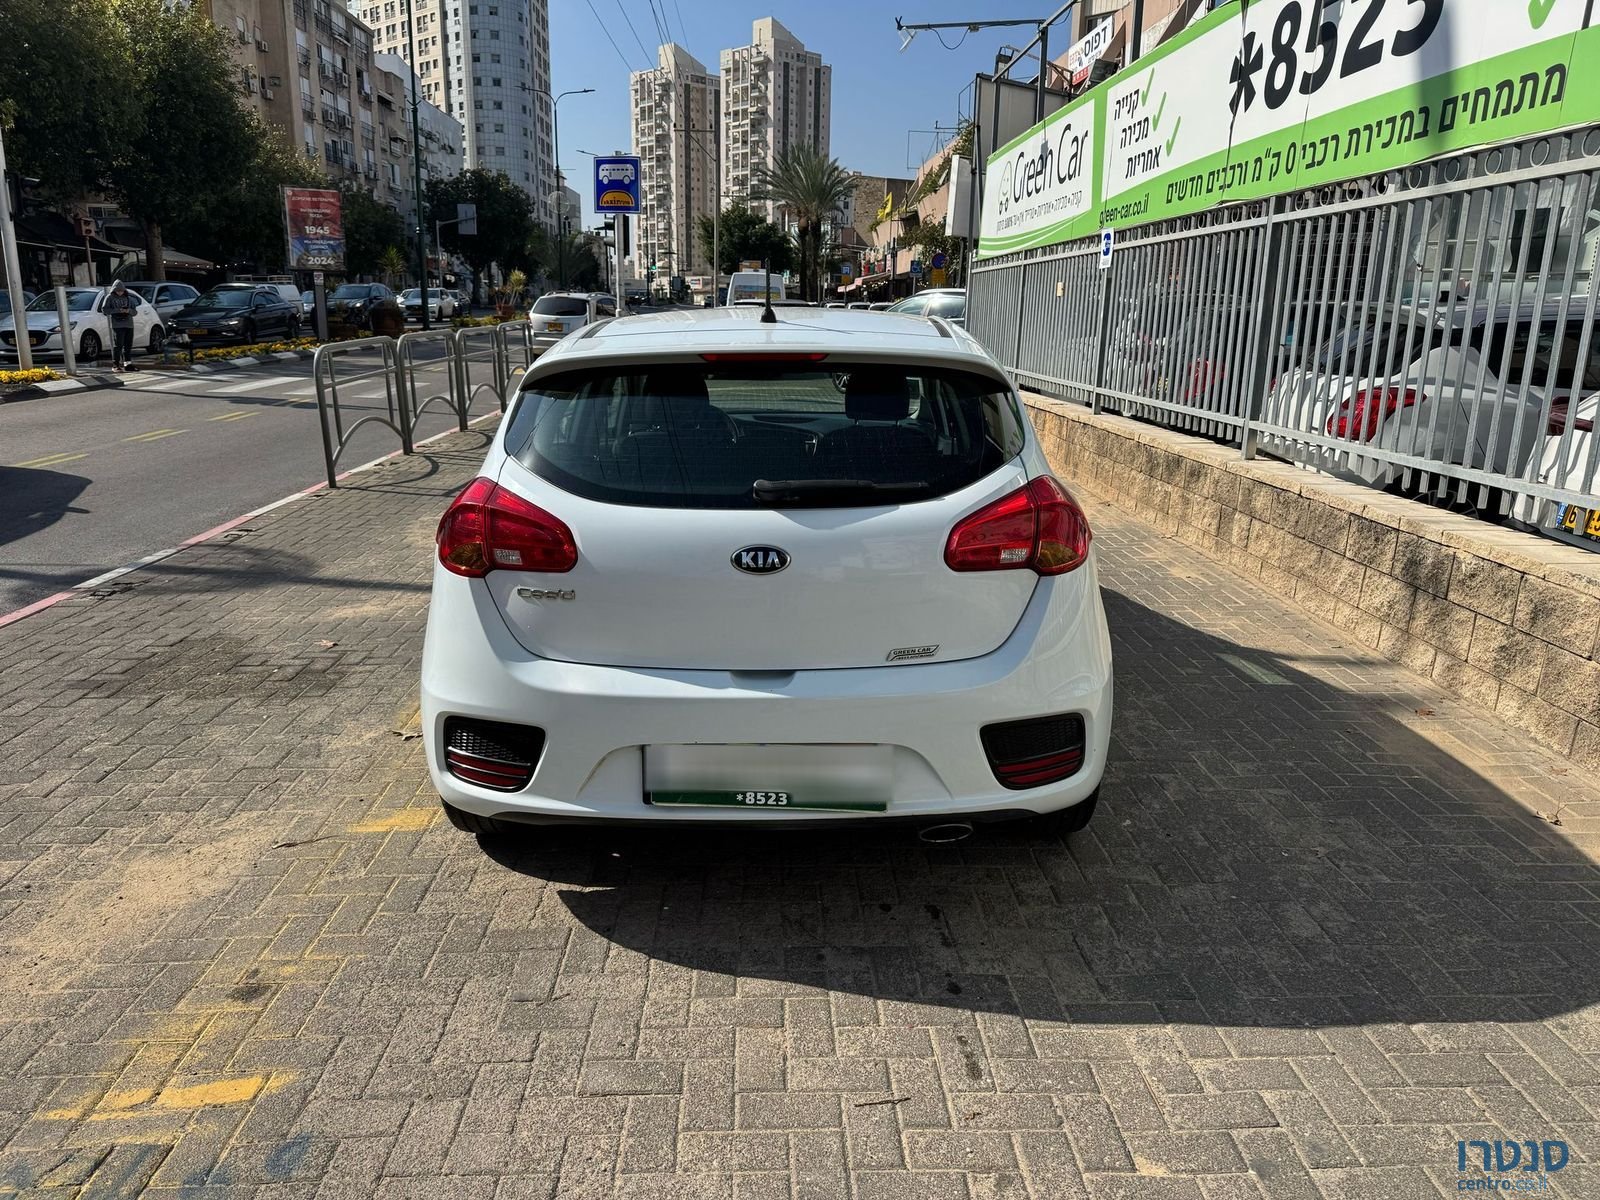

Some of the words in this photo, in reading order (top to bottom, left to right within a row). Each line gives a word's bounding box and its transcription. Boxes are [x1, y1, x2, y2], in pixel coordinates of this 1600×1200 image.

[1084, 25, 1107, 57] דפוס
[1113, 88, 1140, 121] קנייה
[1438, 62, 1567, 134] מתמחים
[1120, 116, 1149, 149] מכירה
[1343, 105, 1430, 160] במכירת
[1013, 148, 1054, 204] Green
[1057, 123, 1089, 184] Car
[1125, 144, 1162, 179] אחריות
[1285, 141, 1297, 175] 0
[1301, 133, 1340, 170] רכבי
[1166, 174, 1203, 204] חדשים
[1206, 160, 1249, 194] ורכבים
[1099, 192, 1150, 228] green-car.co.il
[304, 226, 330, 234] 1945
[307, 257, 335, 265] 2024
[741, 551, 781, 568] KIA
